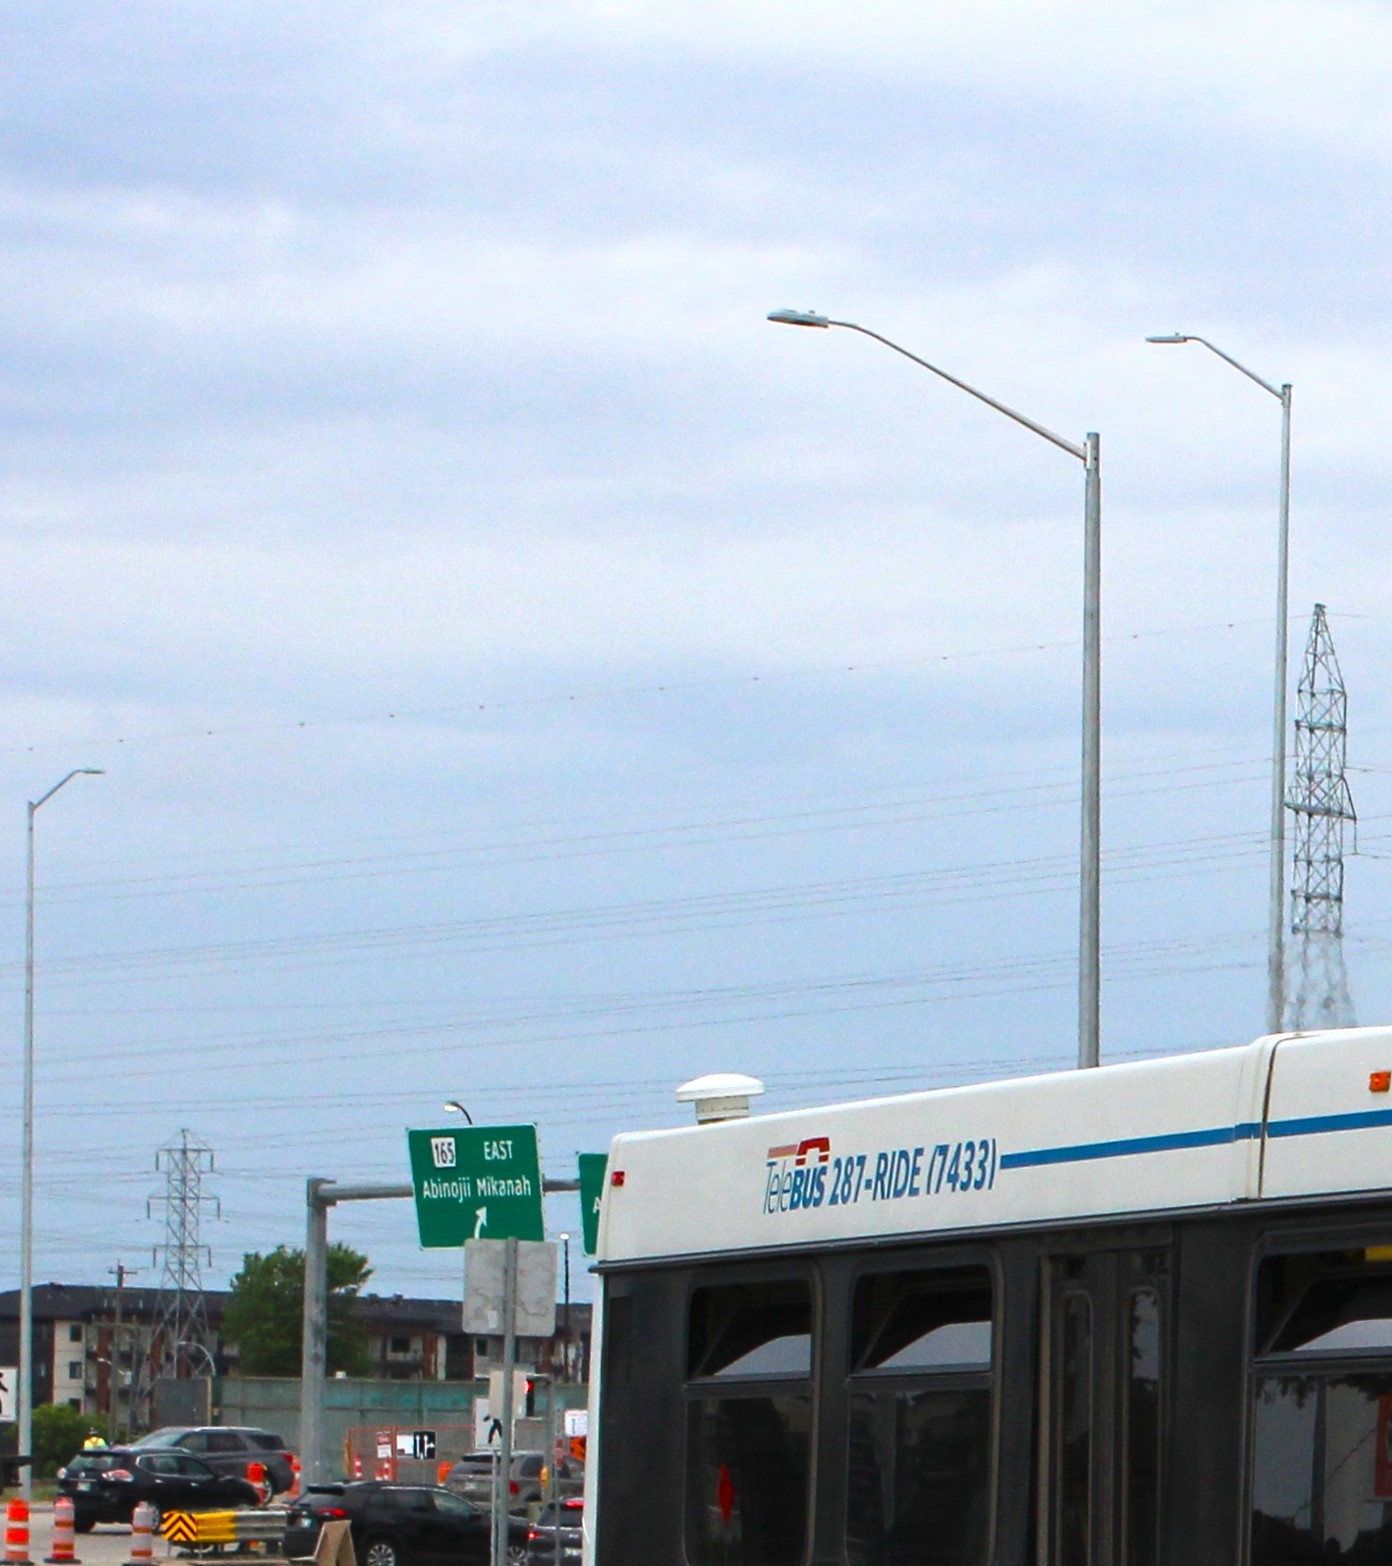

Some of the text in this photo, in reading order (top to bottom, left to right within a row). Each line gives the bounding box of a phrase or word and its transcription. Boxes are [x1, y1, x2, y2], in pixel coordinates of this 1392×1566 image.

[434, 1142, 456, 1165] 165
[483, 1140, 513, 1161] EAST
[423, 1174, 533, 1204] Abinojii Mikanah
[763, 1137, 997, 1215] TeleBUS 287-RIDE (7433)
